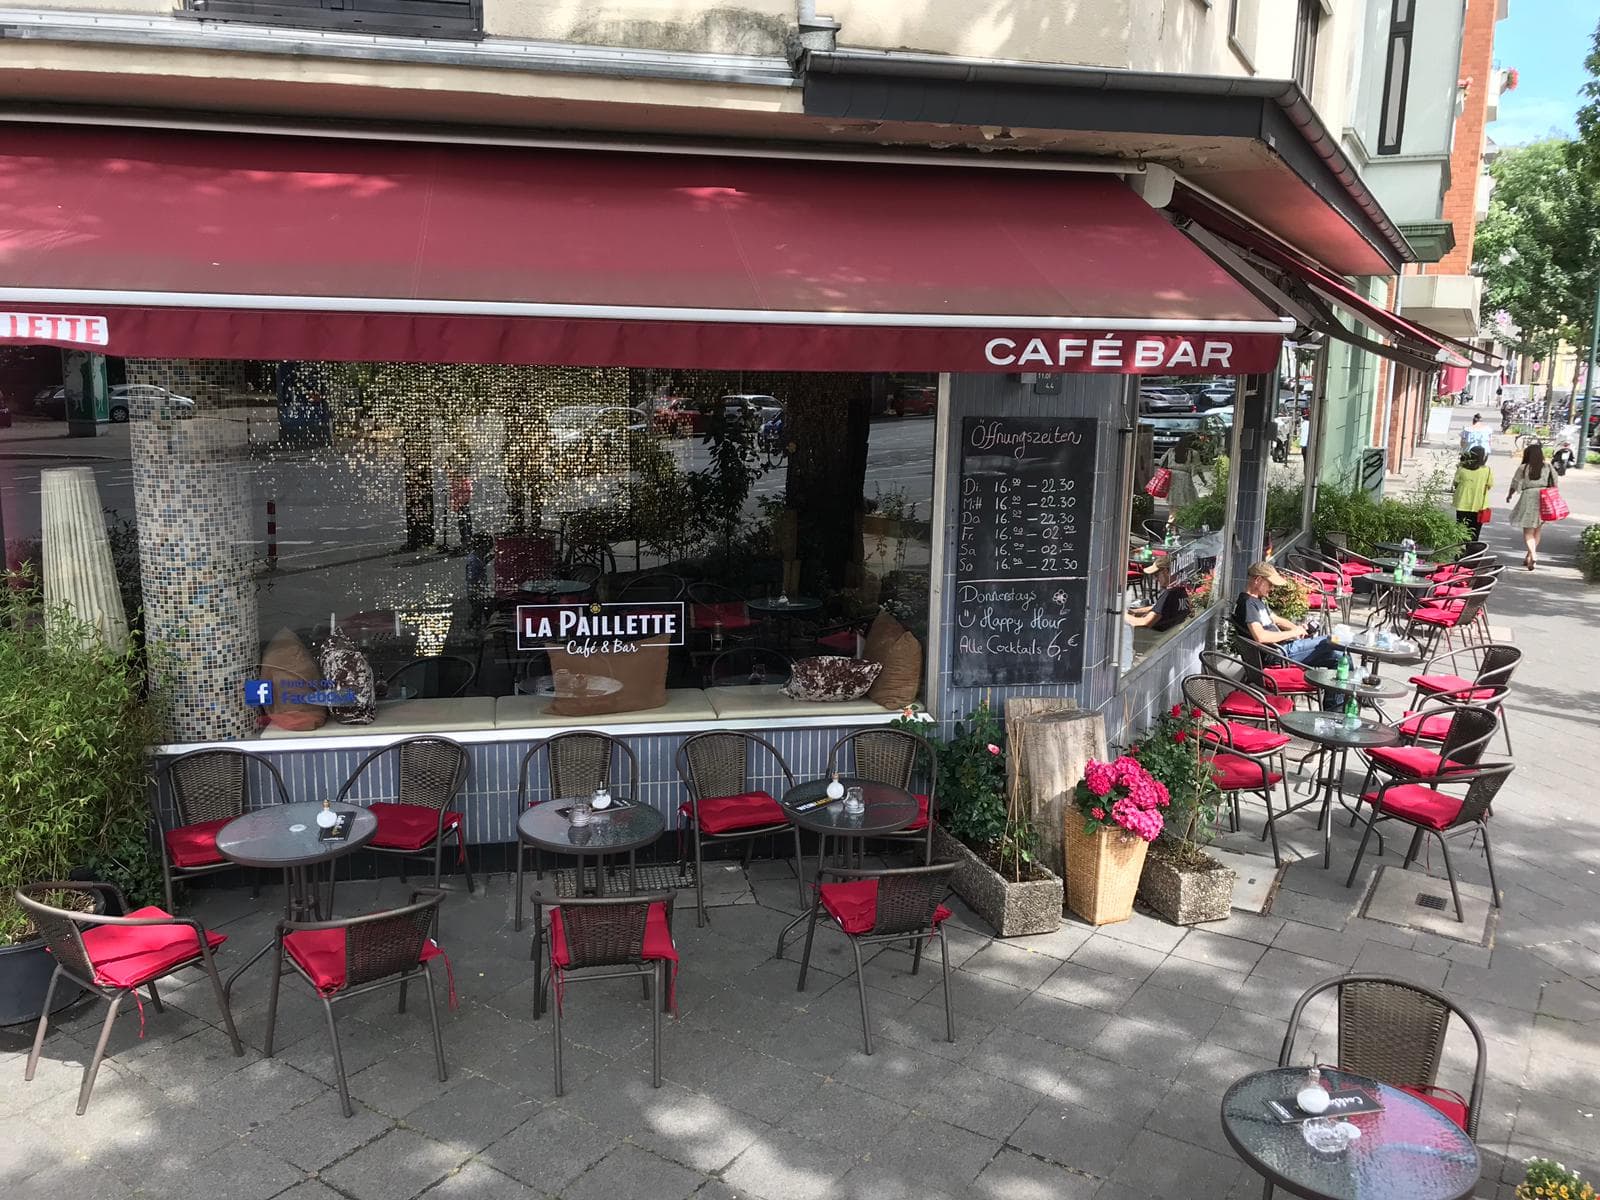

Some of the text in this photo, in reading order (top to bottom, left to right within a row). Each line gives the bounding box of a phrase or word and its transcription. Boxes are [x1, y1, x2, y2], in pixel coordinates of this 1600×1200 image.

[984, 333, 1233, 368] CAFÉ BAR
[971, 418, 1082, 463] Öffnungszeiten
[1041, 478, 1075, 493] 22.30
[959, 543, 976, 556] Sa
[958, 585, 1038, 611] Donnerstags
[525, 610, 676, 638] LA PAILLETTE
[979, 606, 1066, 635] Happy Hour
[566, 637, 639, 658] Café & Bar
[959, 635, 983, 655] Alle
[986, 634, 1042, 655] Cocktails
